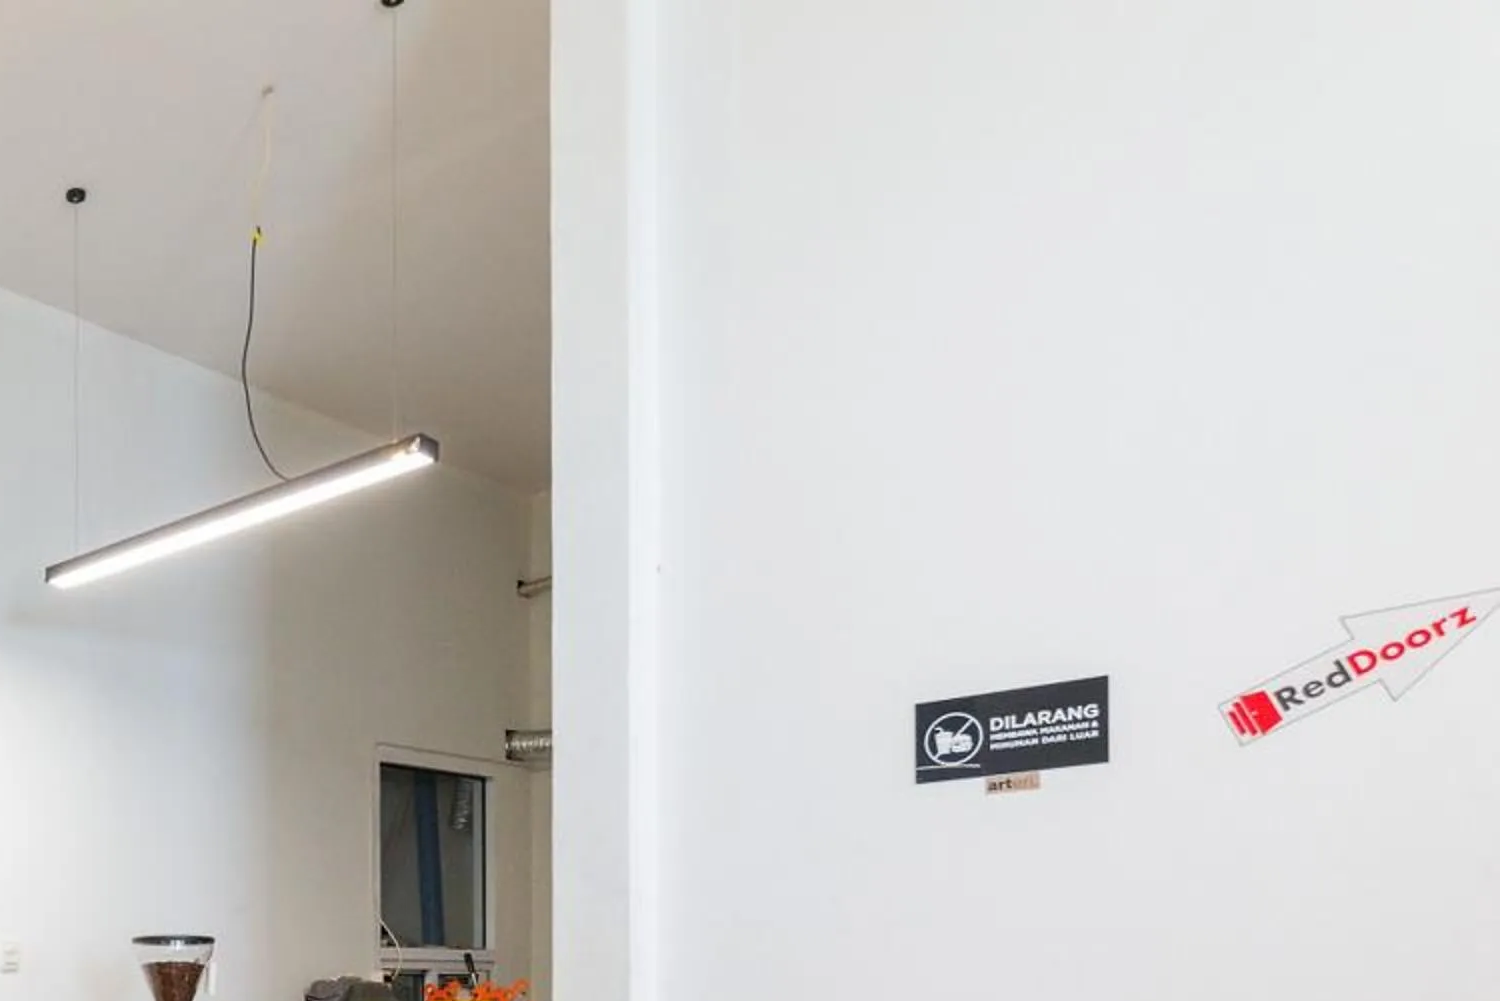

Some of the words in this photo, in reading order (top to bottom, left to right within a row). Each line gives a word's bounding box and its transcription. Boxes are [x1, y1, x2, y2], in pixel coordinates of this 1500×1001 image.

[1273, 606, 1478, 712] RedDoorz
[989, 703, 1100, 732] DILARANG
[1041, 733, 1067, 745] DARI
[1069, 729, 1099, 741] LUAR
